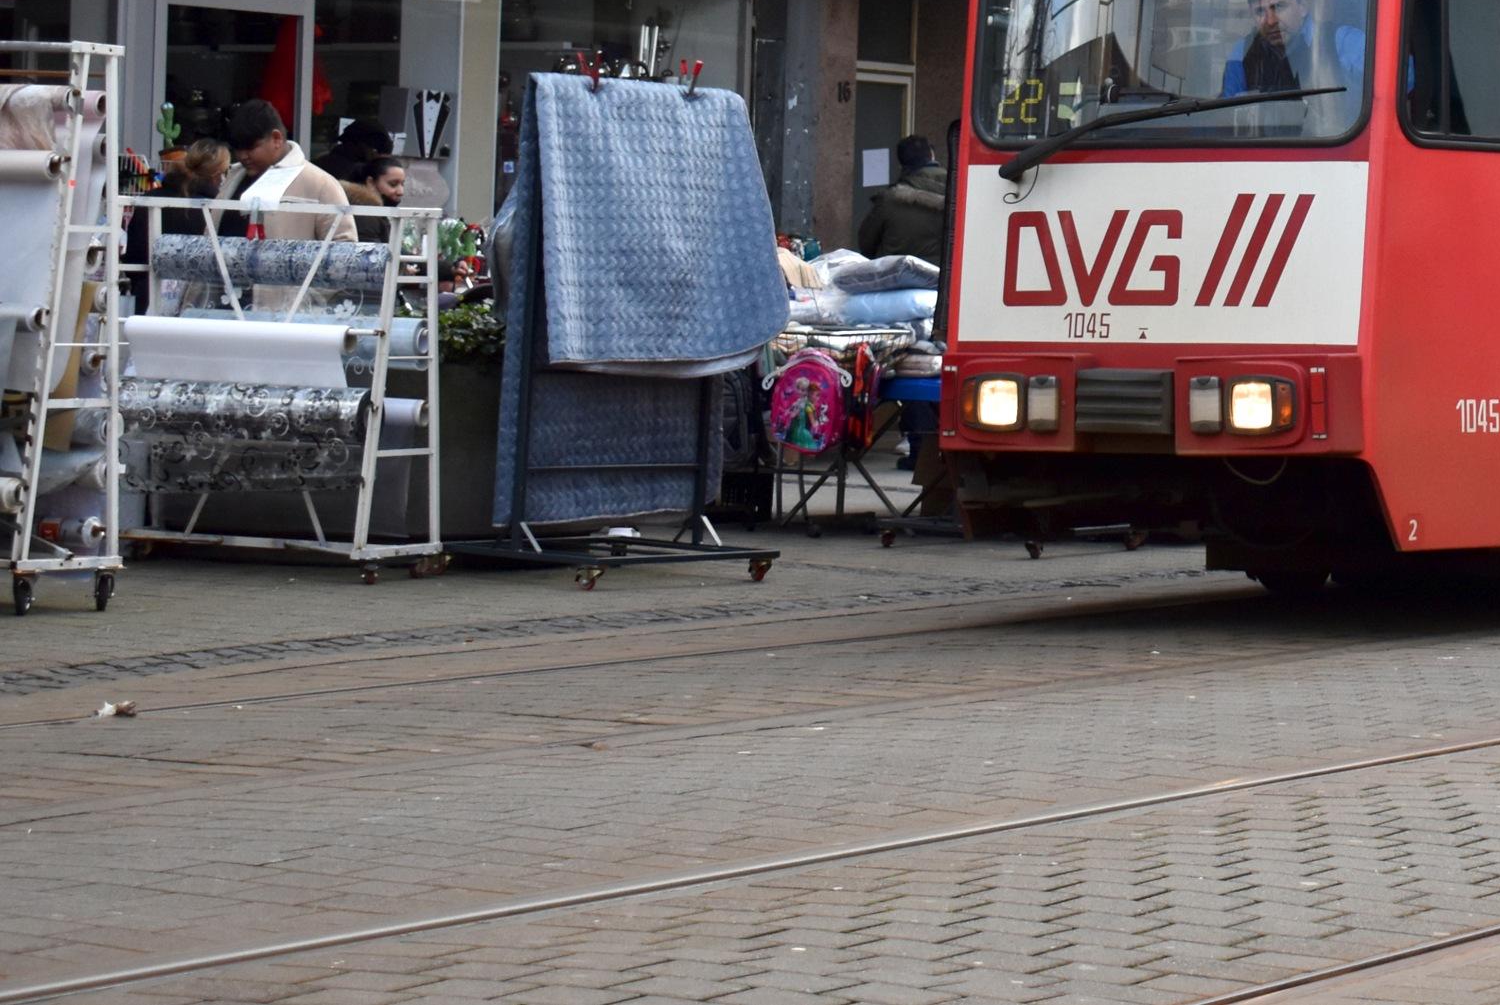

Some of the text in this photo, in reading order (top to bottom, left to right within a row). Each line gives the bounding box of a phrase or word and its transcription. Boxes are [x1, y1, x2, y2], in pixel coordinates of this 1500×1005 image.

[837, 81, 852, 103] 16
[998, 79, 1043, 123] 22
[1002, 209, 1184, 307] DVG
[1064, 312, 1111, 339] 1045
[1456, 399, 1500, 433] 1045
[1408, 519, 1418, 541] 2
